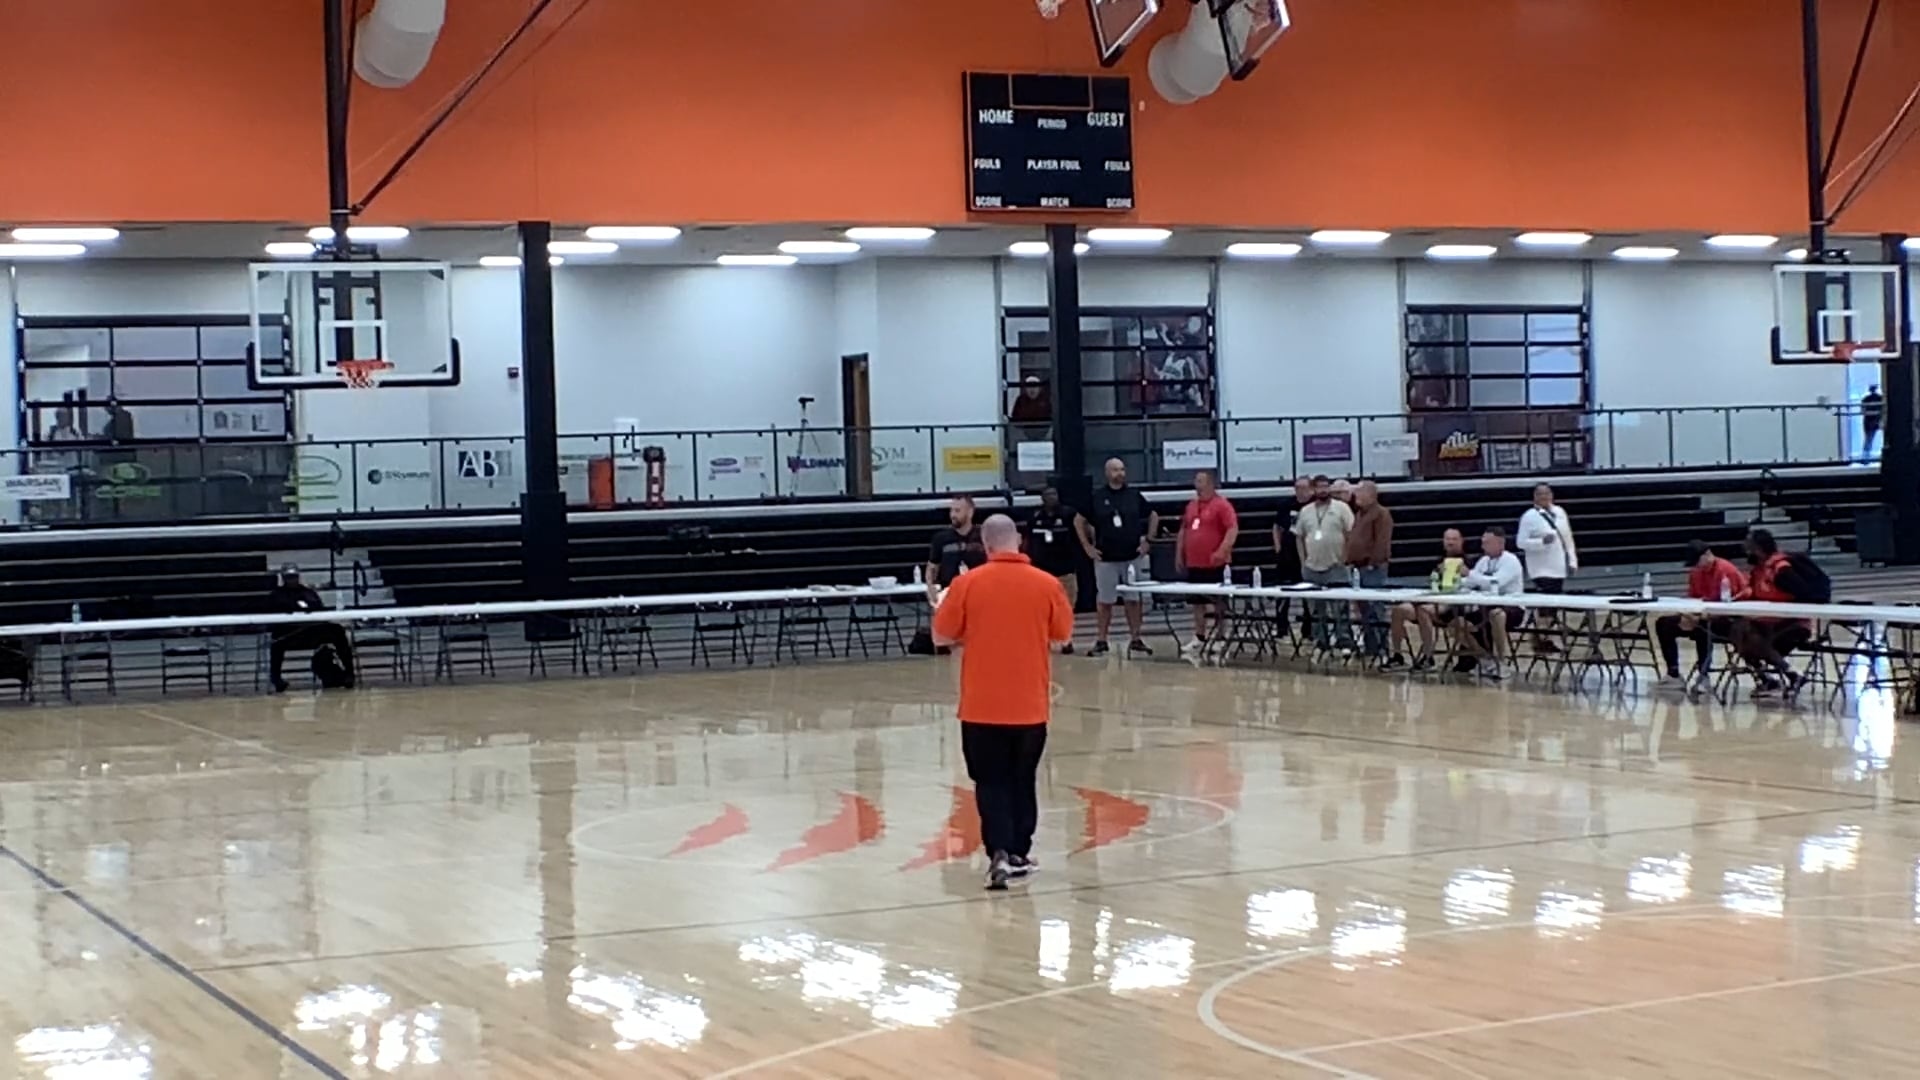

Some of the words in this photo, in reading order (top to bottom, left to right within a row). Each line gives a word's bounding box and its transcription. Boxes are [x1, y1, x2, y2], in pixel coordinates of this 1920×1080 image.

[979, 109, 1014, 124] HOME
[1087, 112, 1125, 127] GUEST
[1037, 118, 1067, 130] PERIOD
[974, 158, 1001, 170] FOULS
[1027, 159, 1058, 170] PLAYER
[1060, 160, 1081, 170] FOUL
[1104, 160, 1130, 171] FOULS
[975, 196, 1002, 207] SCORE
[1040, 197, 1069, 207] MATCH
[1106, 198, 1132, 208] SCORE
